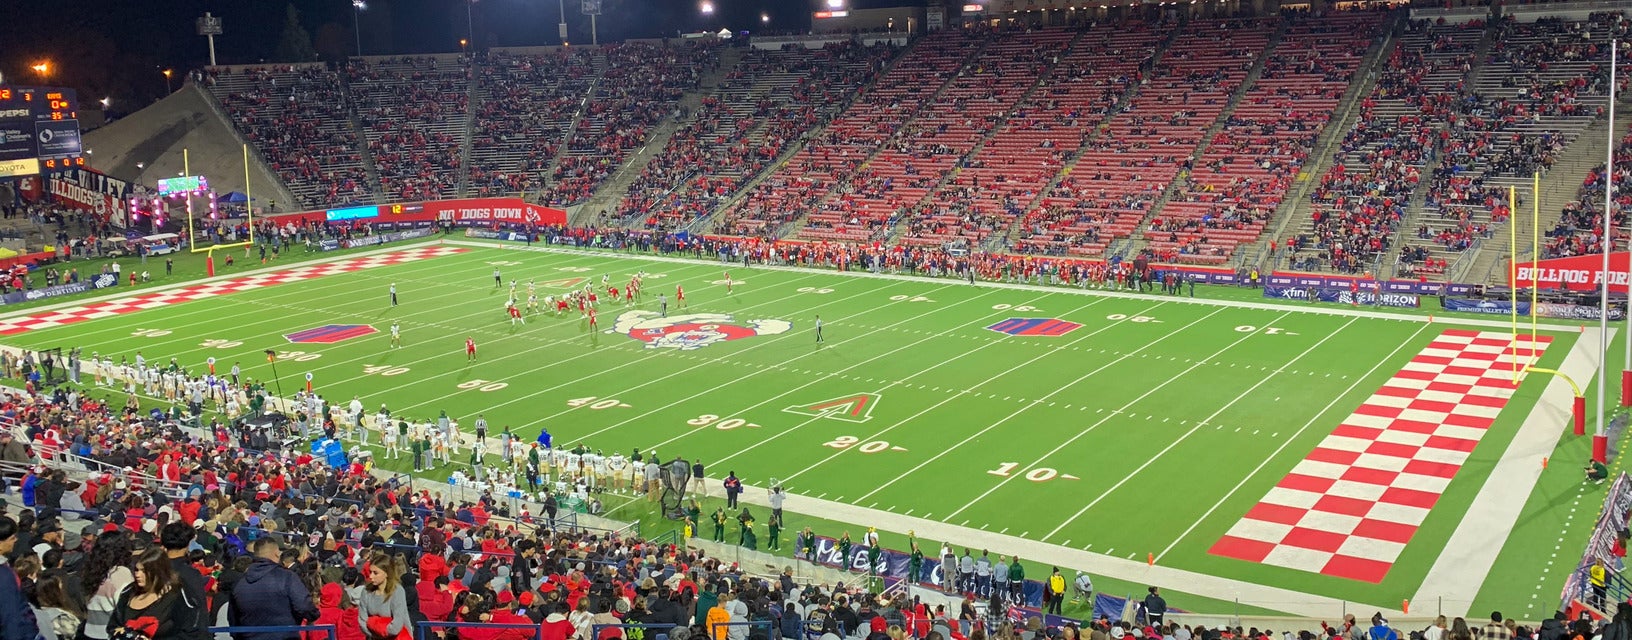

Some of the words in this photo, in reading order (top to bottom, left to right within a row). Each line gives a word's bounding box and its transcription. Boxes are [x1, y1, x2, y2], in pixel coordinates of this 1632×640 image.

[0, 109, 29, 117] PEPSI
[439, 209, 455, 220] NO
[494, 208, 522, 218] DOWN
[1516, 267, 1590, 283] BULLDOG
[46, 285, 86, 297] DENTISTRY
[686, 414, 746, 430] 30
[821, 435, 890, 453] 20
[986, 462, 1058, 483] 10
